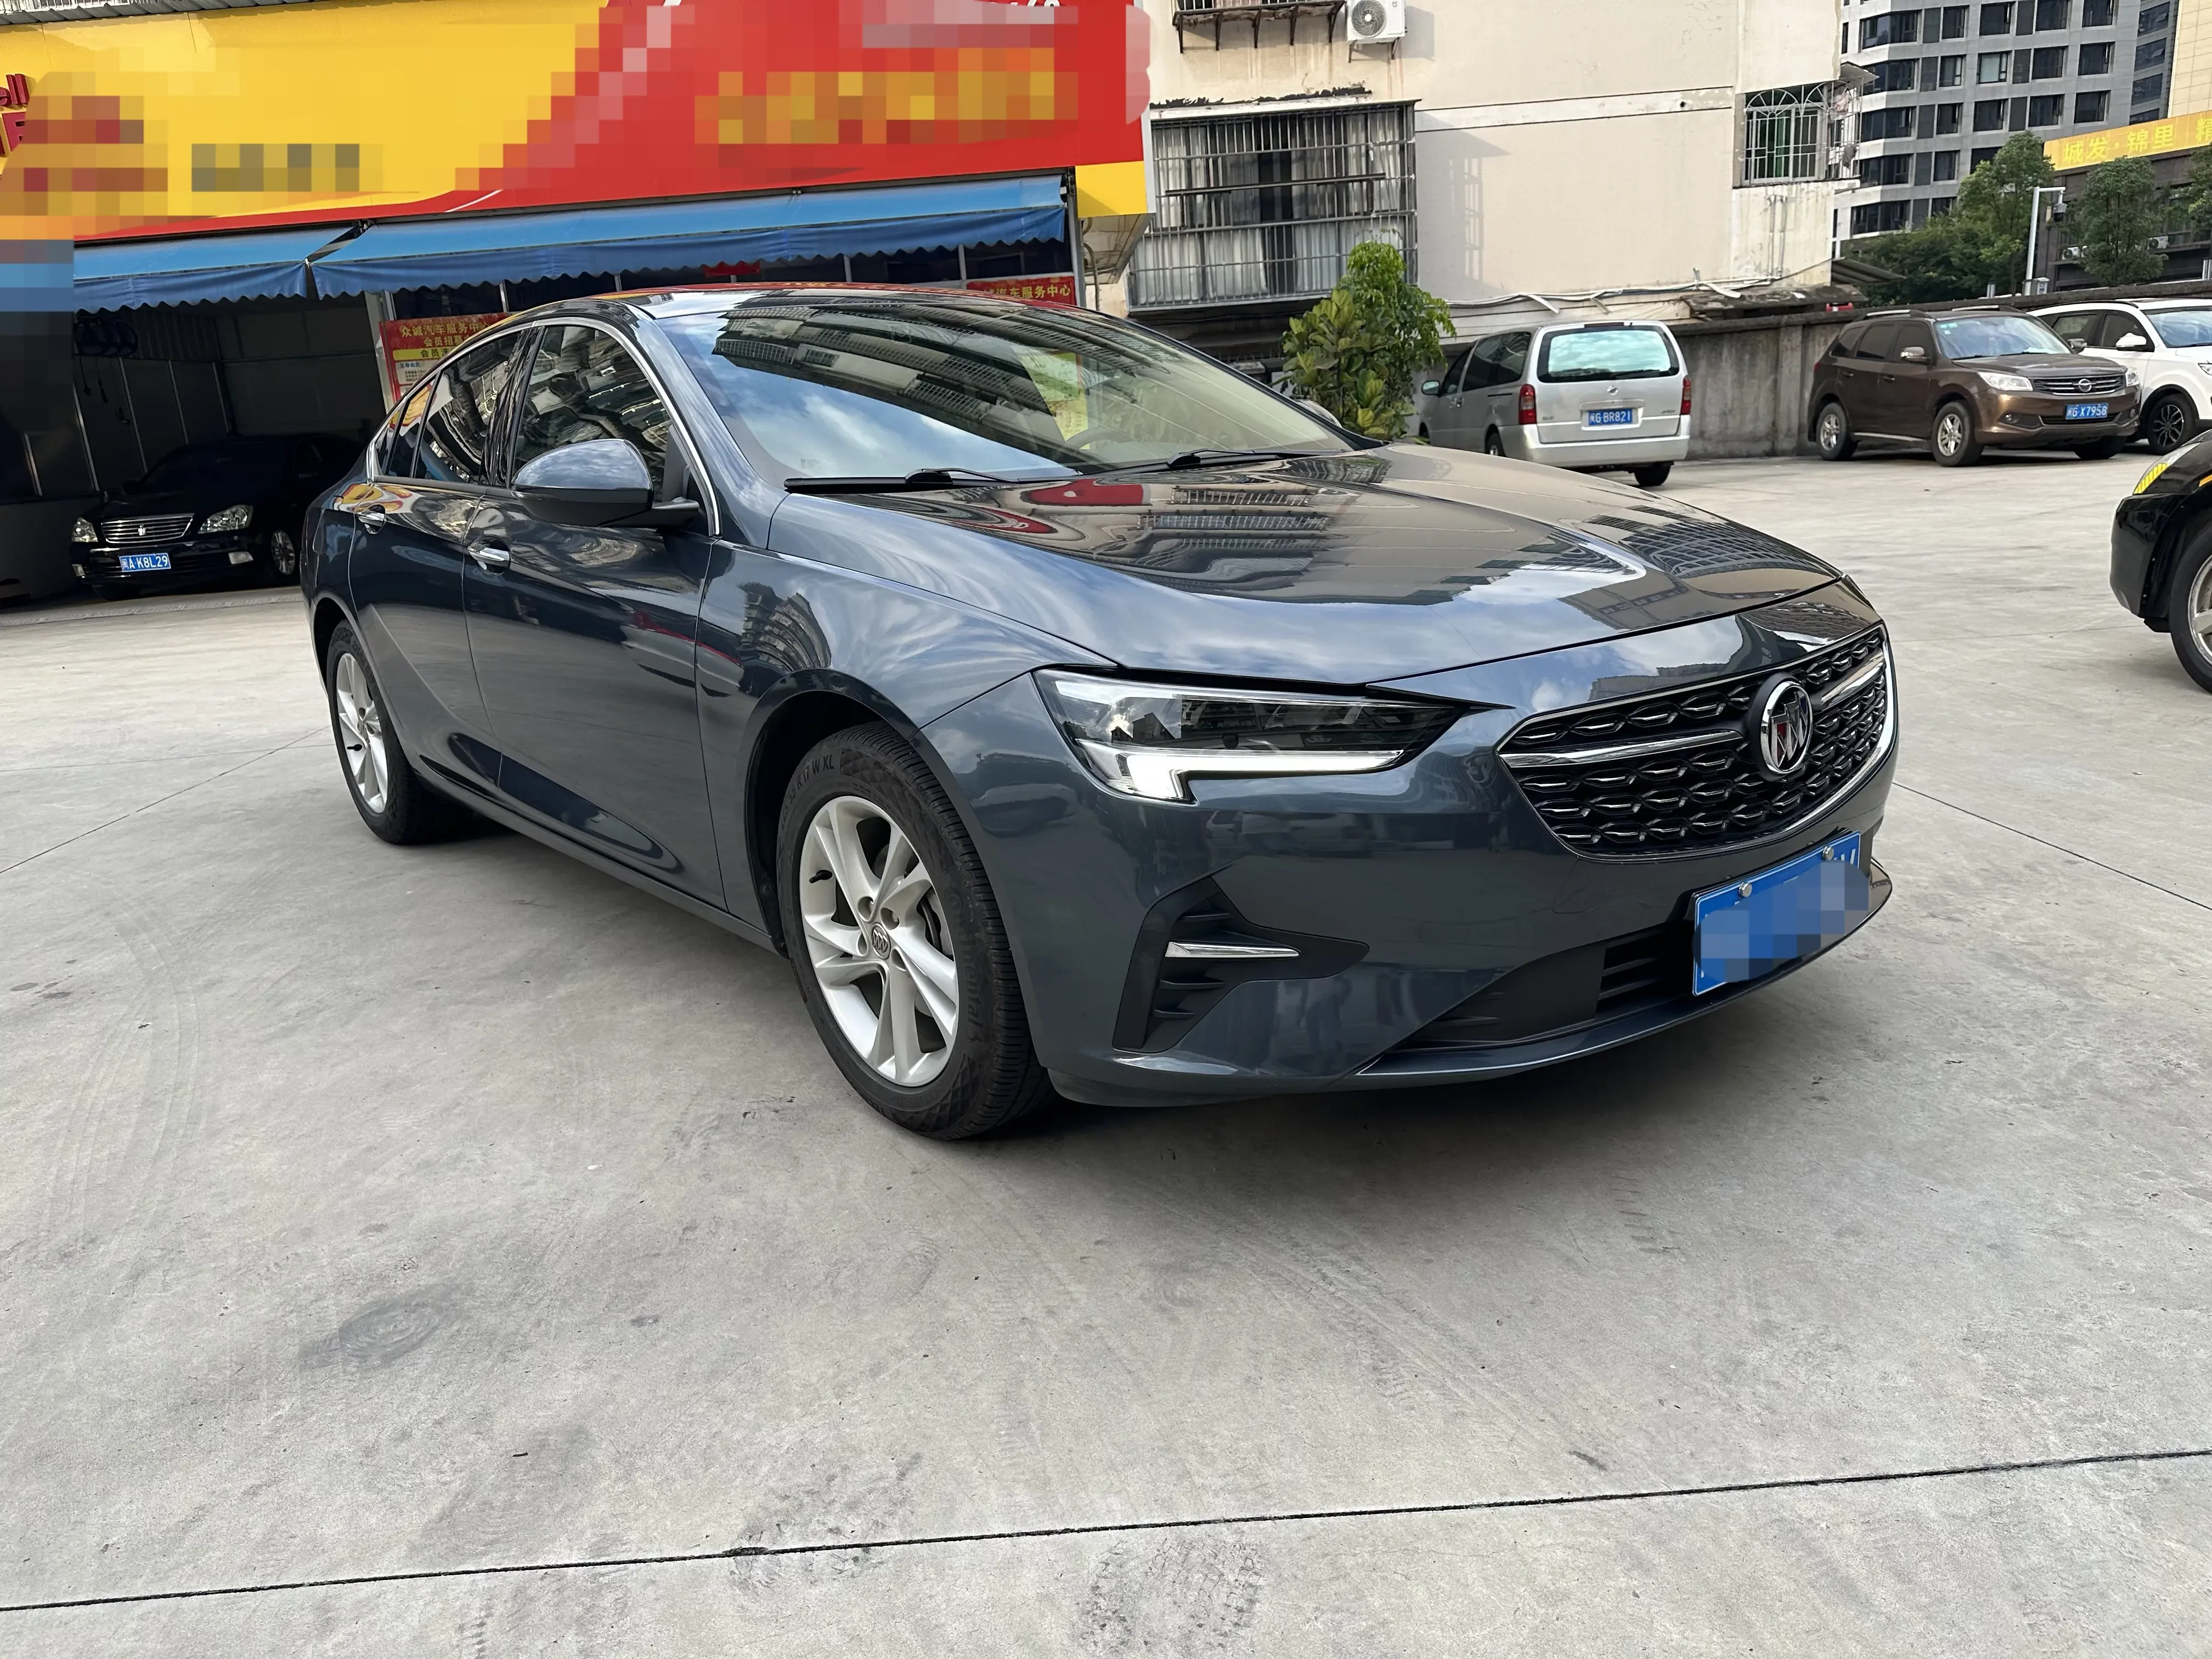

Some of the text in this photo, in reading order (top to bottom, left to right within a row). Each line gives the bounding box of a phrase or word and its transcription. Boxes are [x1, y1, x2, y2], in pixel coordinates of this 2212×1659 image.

[984, 284, 1070, 299] 汽车服务中心
[797, 776, 803, 791] R
[803, 765, 810, 782] 17
[812, 758, 820, 775] W
[822, 754, 834, 771] XL
